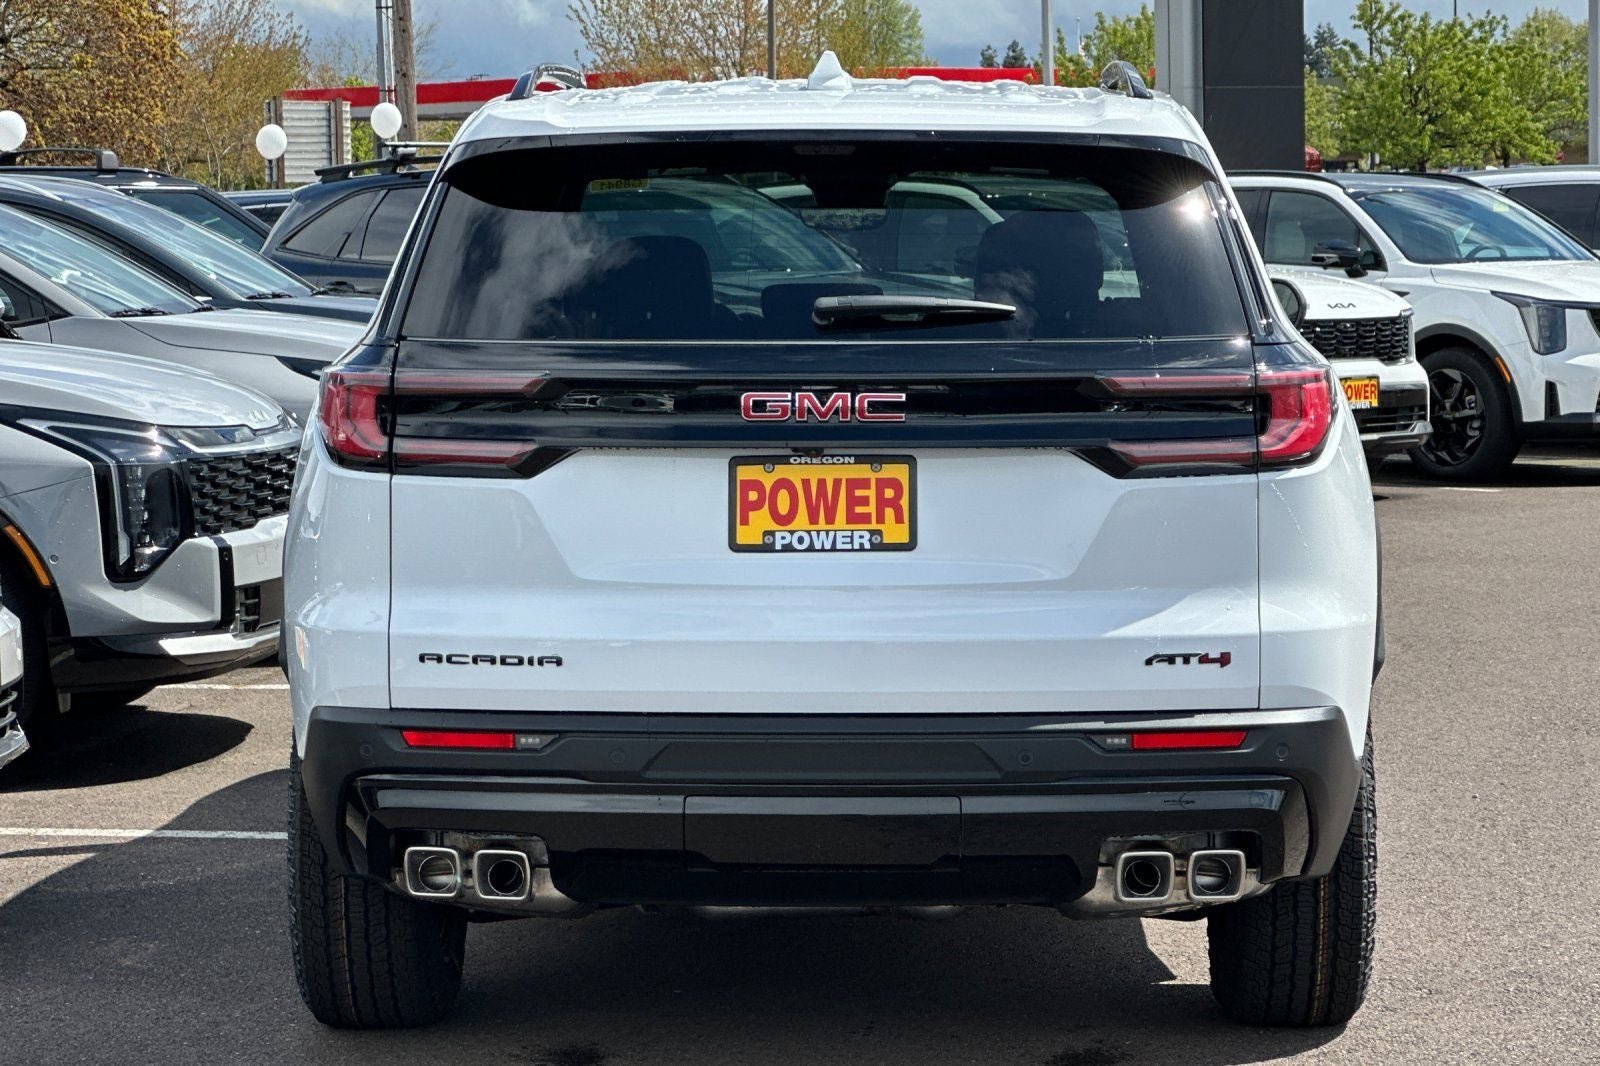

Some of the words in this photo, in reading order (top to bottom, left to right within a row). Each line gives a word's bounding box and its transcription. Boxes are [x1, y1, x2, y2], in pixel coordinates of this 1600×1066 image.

[1343, 382, 1377, 401] OWER
[741, 391, 907, 422] GMC
[789, 456, 855, 464] OREGON
[739, 477, 905, 527] POWER
[774, 530, 872, 550] POWER
[418, 652, 563, 667] ACADIA
[1144, 651, 1232, 669] AT4
